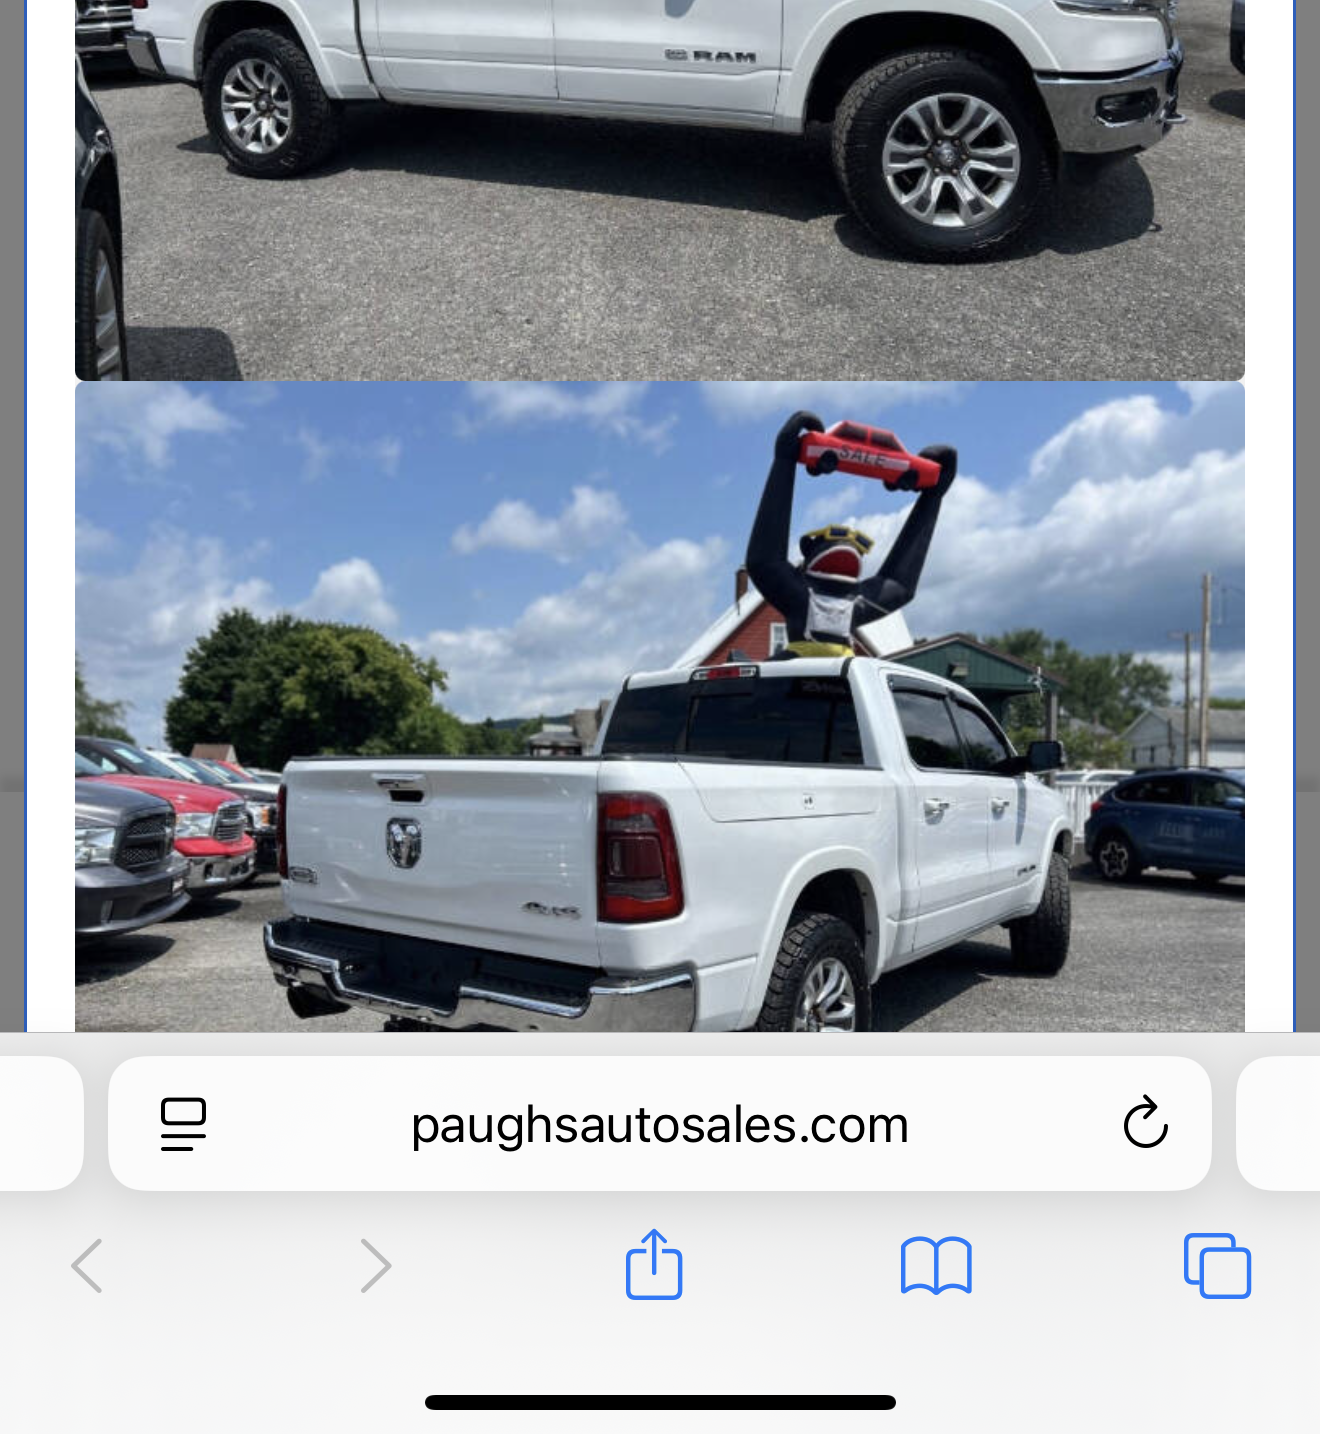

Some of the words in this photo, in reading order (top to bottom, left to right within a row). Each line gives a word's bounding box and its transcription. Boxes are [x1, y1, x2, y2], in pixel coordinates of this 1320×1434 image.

[693, 50, 756, 64] RAM
[840, 445, 886, 466] SALE
[413, 1103, 908, 1152] paughsautosales.com
